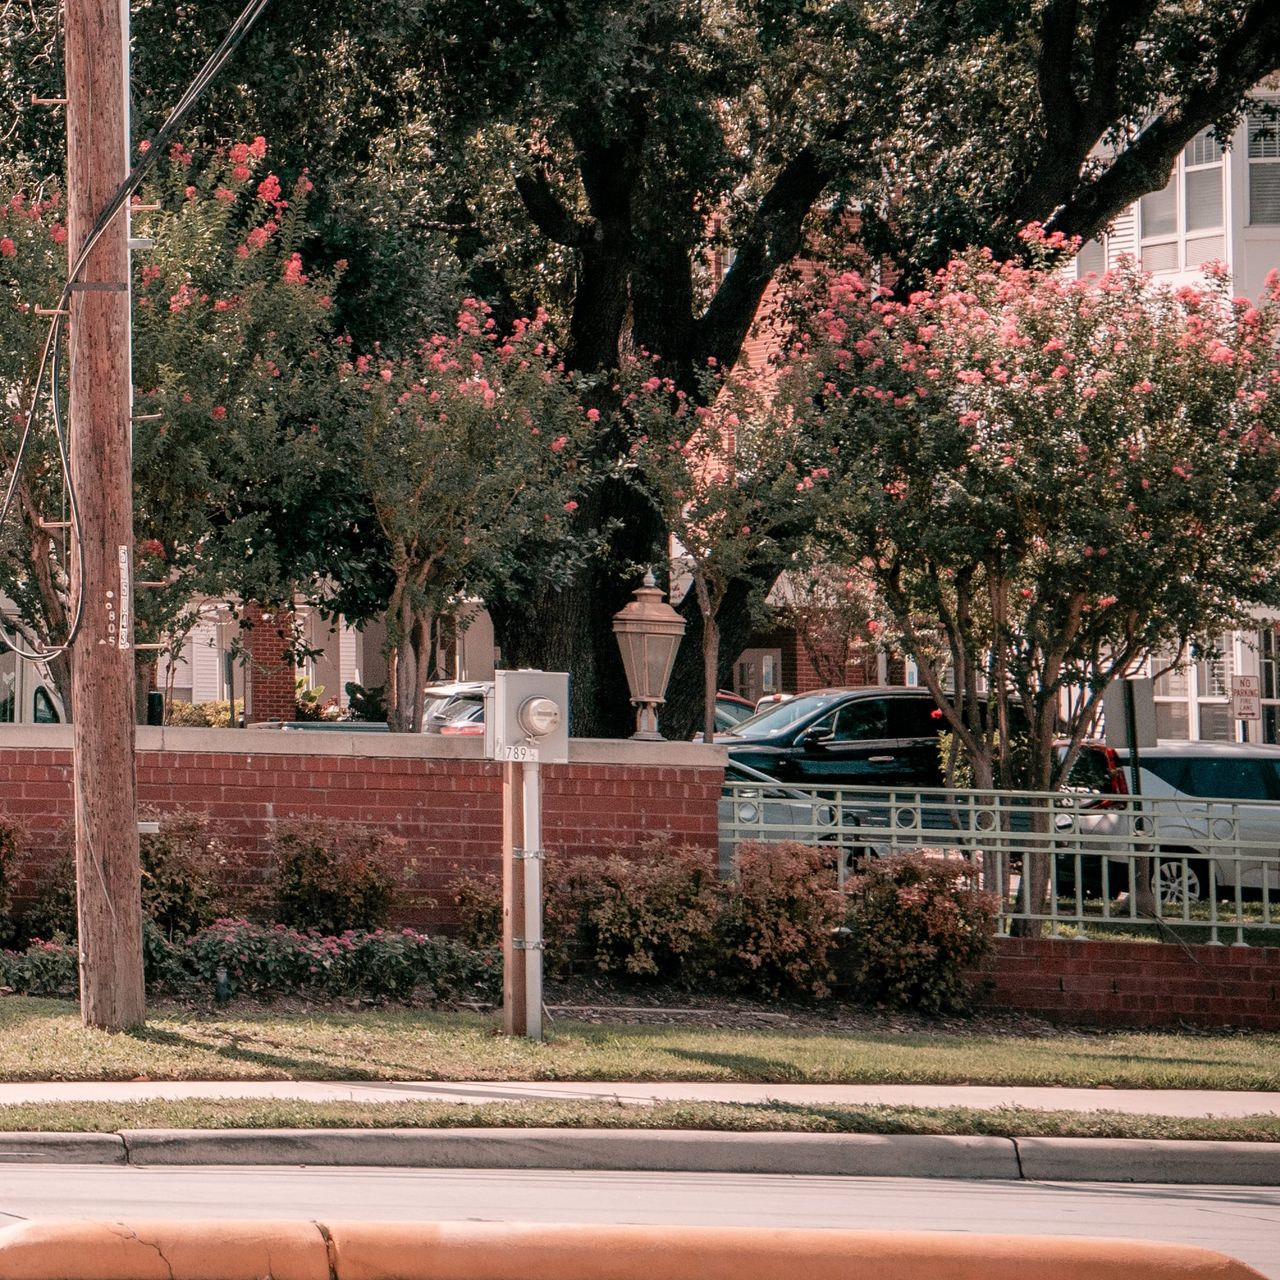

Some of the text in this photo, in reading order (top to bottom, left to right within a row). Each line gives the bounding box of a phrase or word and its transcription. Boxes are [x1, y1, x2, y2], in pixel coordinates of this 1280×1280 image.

[1240, 679, 1250, 687] NO
[1232, 689, 1258, 697] PARKING
[507, 747, 527, 760] 789
